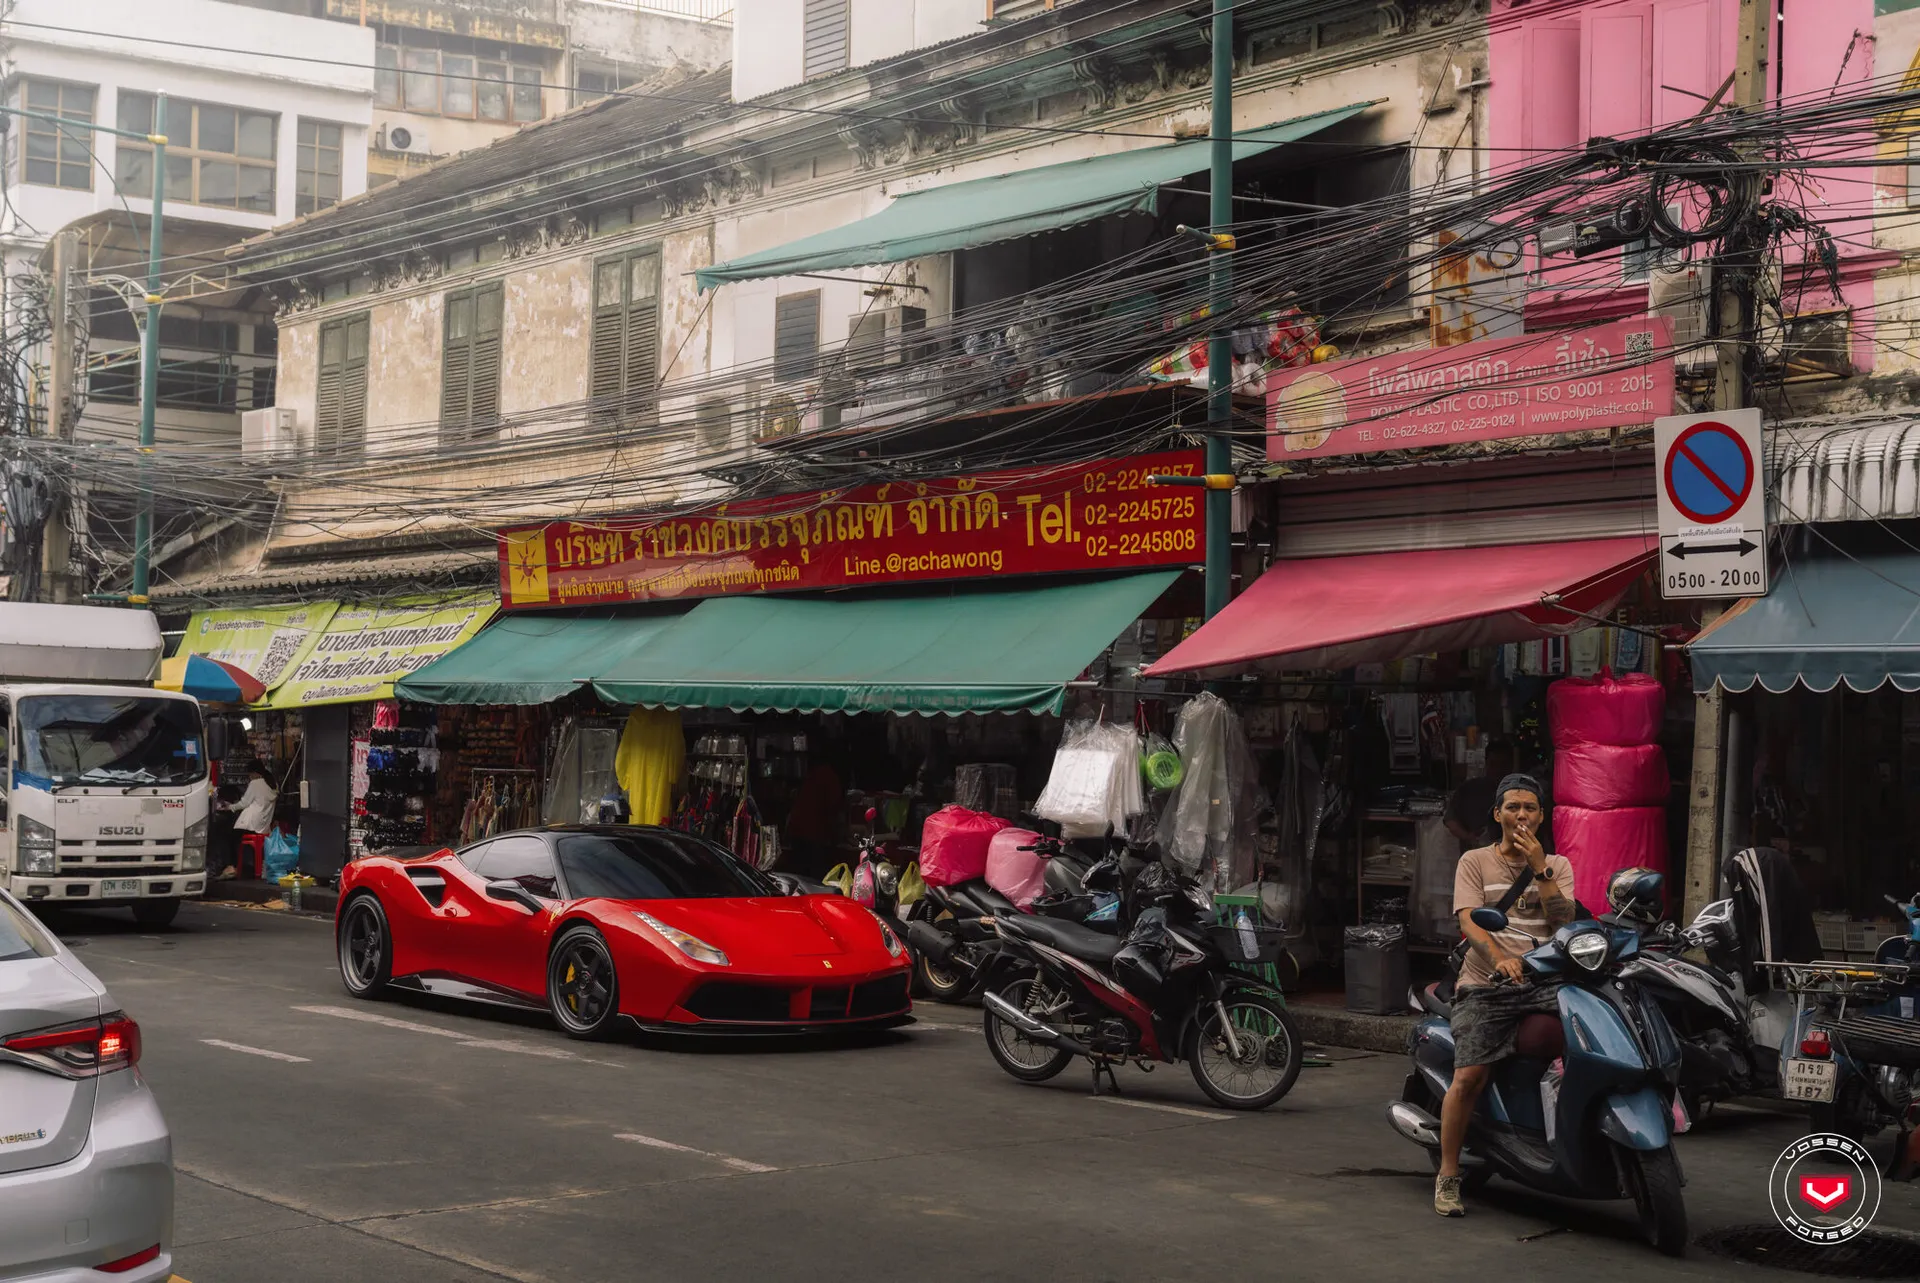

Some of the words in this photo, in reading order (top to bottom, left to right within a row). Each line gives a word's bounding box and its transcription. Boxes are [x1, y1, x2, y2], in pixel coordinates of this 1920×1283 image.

[1468, 390, 1521, 411] CO.,LTD.
[1536, 385, 1561, 402] ISO
[1568, 381, 1603, 399] 9001
[1621, 375, 1654, 394] 2015
[1358, 430, 1374, 441] TEL
[1451, 414, 1515, 432] 02-225-0124
[907, 477, 1000, 535] จำกัด
[1017, 491, 1081, 546] Tel.
[1085, 497, 1195, 525] 02-2245725
[1086, 529, 1196, 557] 02-2245808
[844, 550, 1003, 576] Line.@rachawong
[1668, 572, 1706, 589] 0500
[1720, 569, 1760, 586] 2000
[99, 826, 144, 836] ISUZU
[1797, 1086, 1822, 1099] 187
